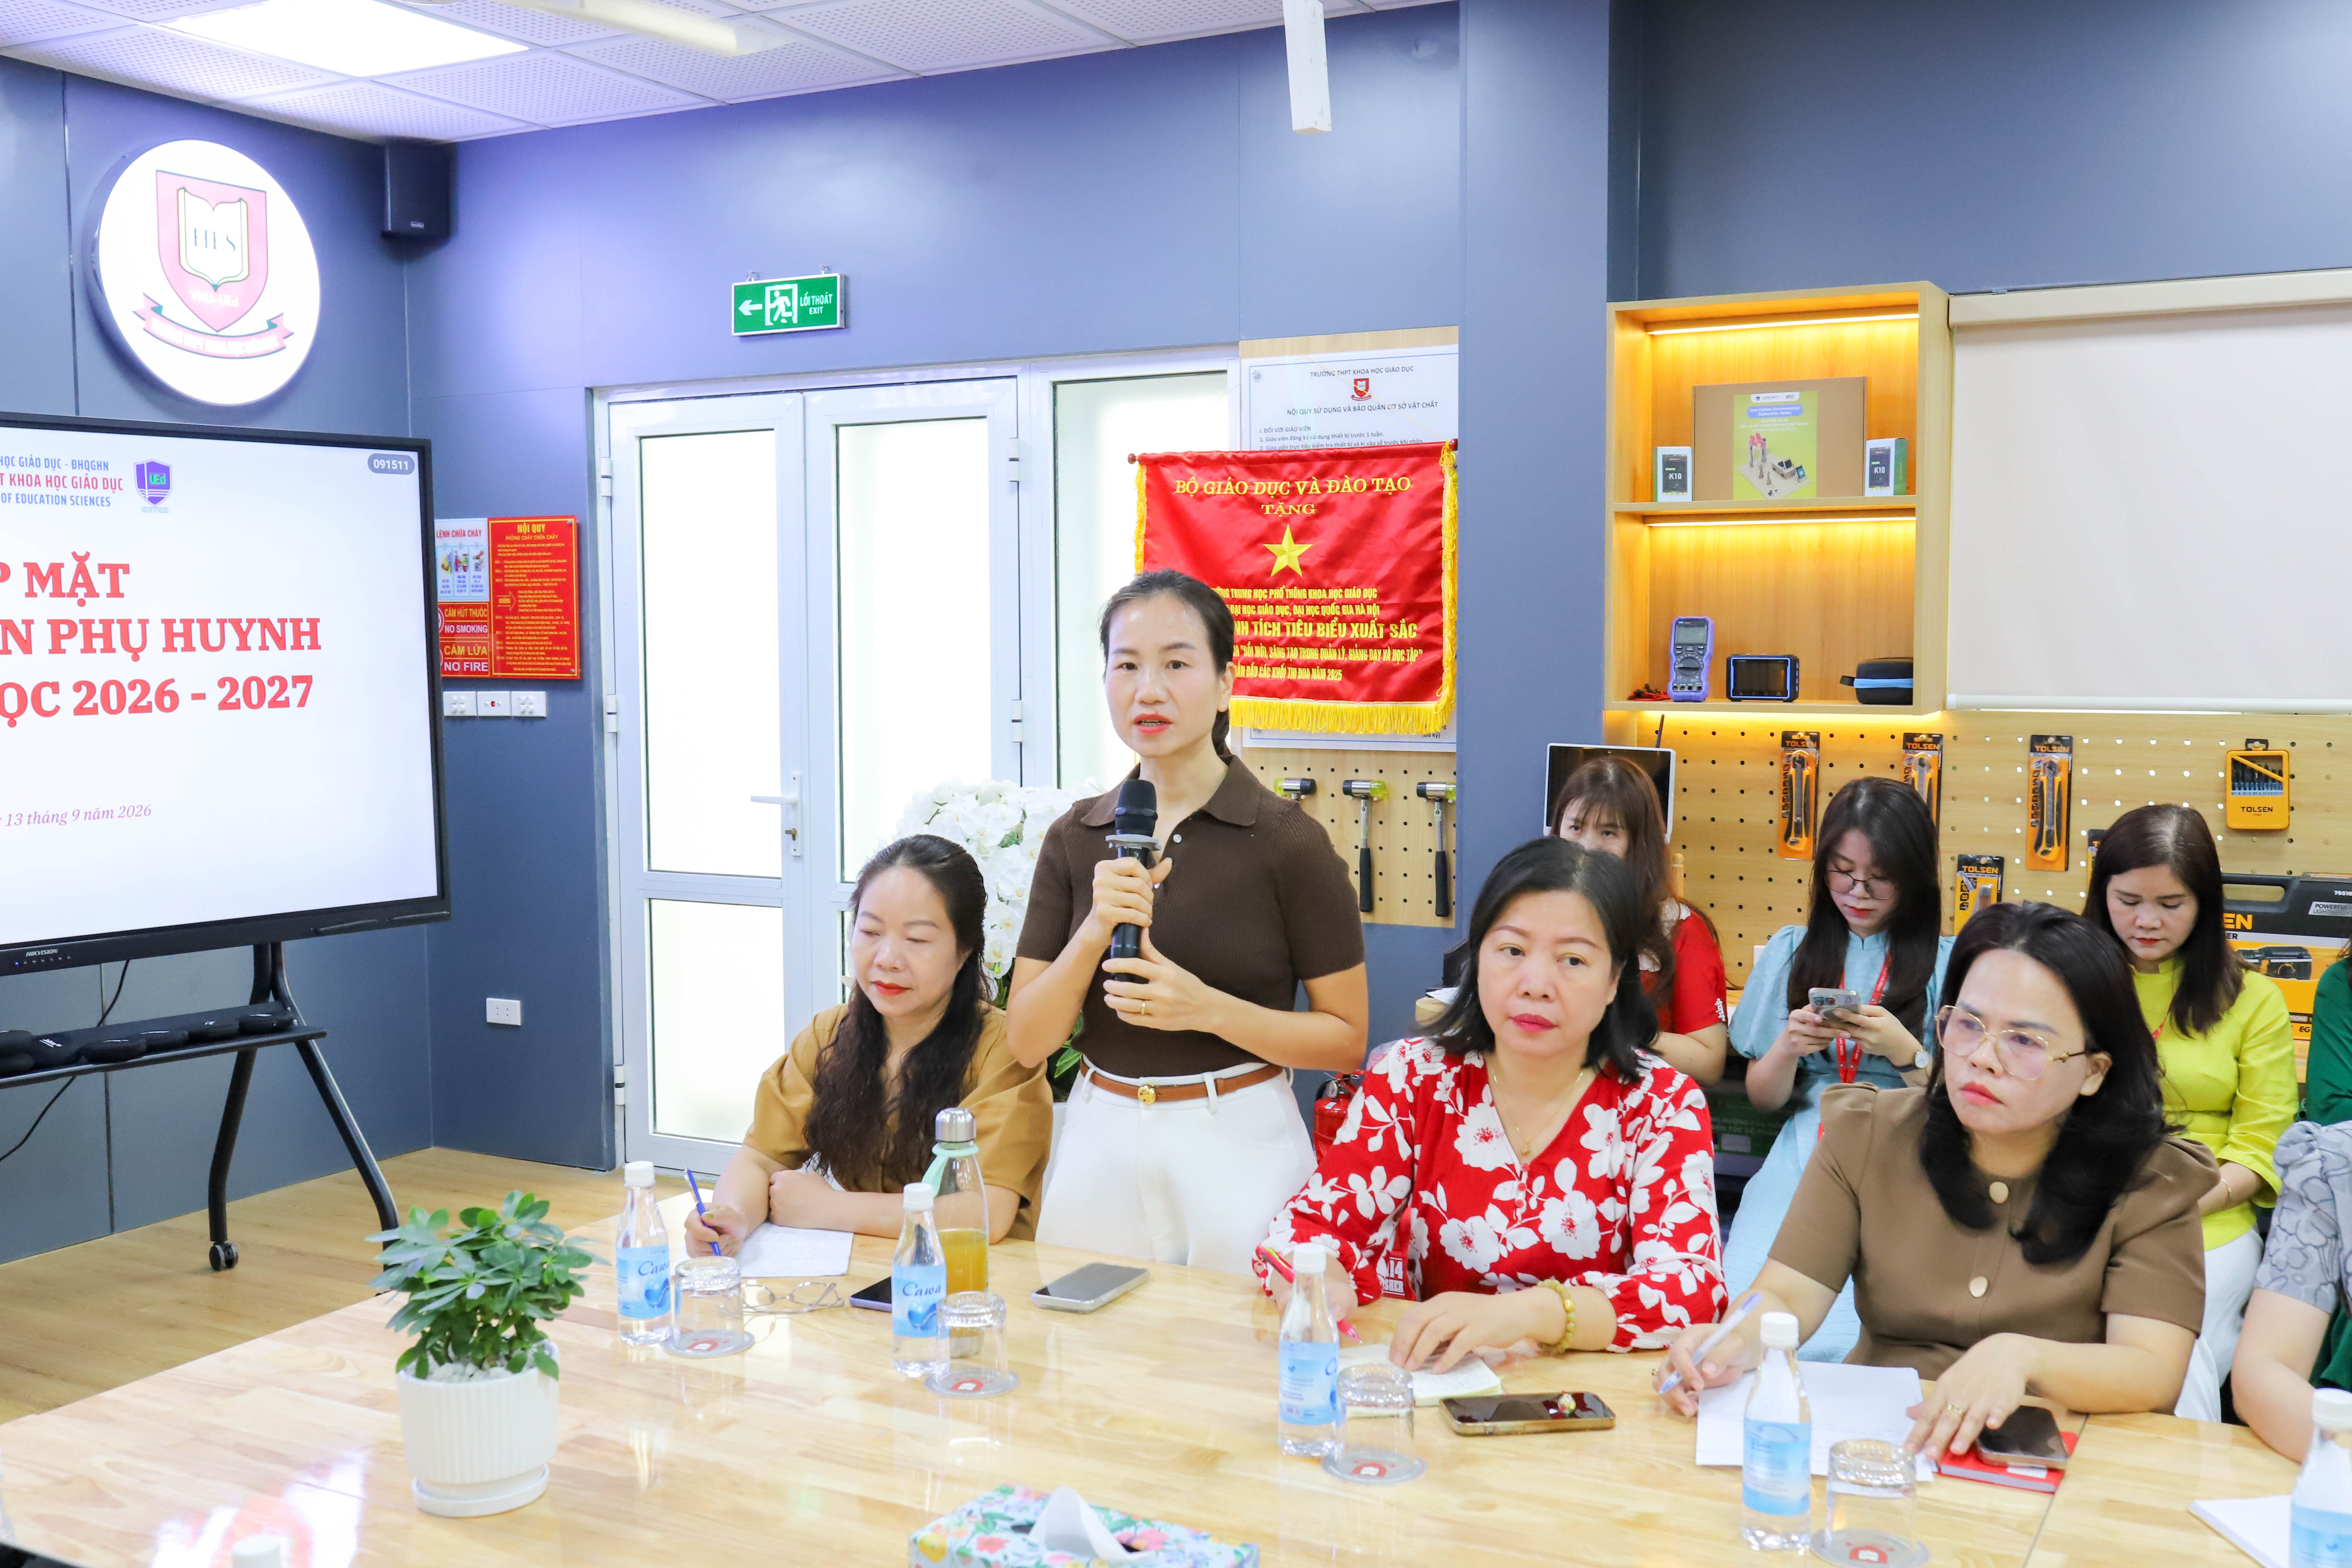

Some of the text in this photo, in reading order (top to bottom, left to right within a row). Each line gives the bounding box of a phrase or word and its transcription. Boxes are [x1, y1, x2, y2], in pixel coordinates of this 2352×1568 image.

[800, 291, 833, 306] LỐI THOÁT
[809, 306, 823, 315] EXIT
[1353, 404, 1366, 412] BẢO
[1367, 403, 1385, 411] QUẢN
[1408, 401, 1420, 410] VẬT
[1422, 400, 1438, 408] CHẤT
[19, 455, 109, 472] GIÁO DỤC ĐHQGHN
[373, 459, 409, 471] 091511
[9, 473, 123, 493] KHOA HỌC GIÁO DỤC
[1175, 475, 1411, 498] BỘ GIÁO DỤC VÀ ĐÀO TẠO
[2, 493, 111, 507] OF EDUCATION SCIENCES
[1261, 502, 1316, 517] TẶNG
[468, 528, 482, 537] CHÁY
[517, 522, 545, 535] NỘI QUY
[23, 551, 130, 608] MẶT
[1230, 588, 1252, 599] TRUNG
[1253, 589, 1268, 601] HỌC
[1286, 586, 1307, 599] THÔNG
[1308, 588, 1327, 599] KHOA
[1329, 588, 1343, 601] HỌC
[1344, 586, 1361, 599] GIÁO
[1363, 588, 1377, 600] DỤC
[444, 605, 488, 618] CẤM HÚT THUỐC
[1230, 602, 1380, 617] ĐẠI HỌC GIÁO DỤC, ĐẠI HỌC QUỐC GIA HÀ NỘI
[456, 624, 488, 633] SMOKING
[1251, 616, 1418, 638] TÍCH TIÊU BIỂU XUẤT SẮC
[48, 619, 149, 662] PHỤ
[161, 618, 321, 653] HUYNH
[444, 644, 465, 656] CẤM
[1269, 644, 1285, 659] SÁNG
[1286, 647, 1298, 661] TẠO
[1299, 647, 1319, 659] TRONG
[1320, 643, 1337, 661] QUẢN
[1348, 644, 1368, 661] GIẢNG
[1369, 649, 1382, 664] DẠY
[1383, 646, 1391, 661] VÀ
[1392, 649, 1405, 664] HỌC
[444, 661, 488, 672] NO FIRE
[1246, 662, 1342, 681] ĐẦU CÁC KHỐI THI ĐUA NĂM 2025
[73, 678, 179, 716] 2026
[217, 675, 313, 710] 2027
[6, 803, 151, 829] 13 tháng 9 năm 2026
[1962, 866, 1999, 874] TOLSEN
[26, 949, 58, 957] HIKVISION
